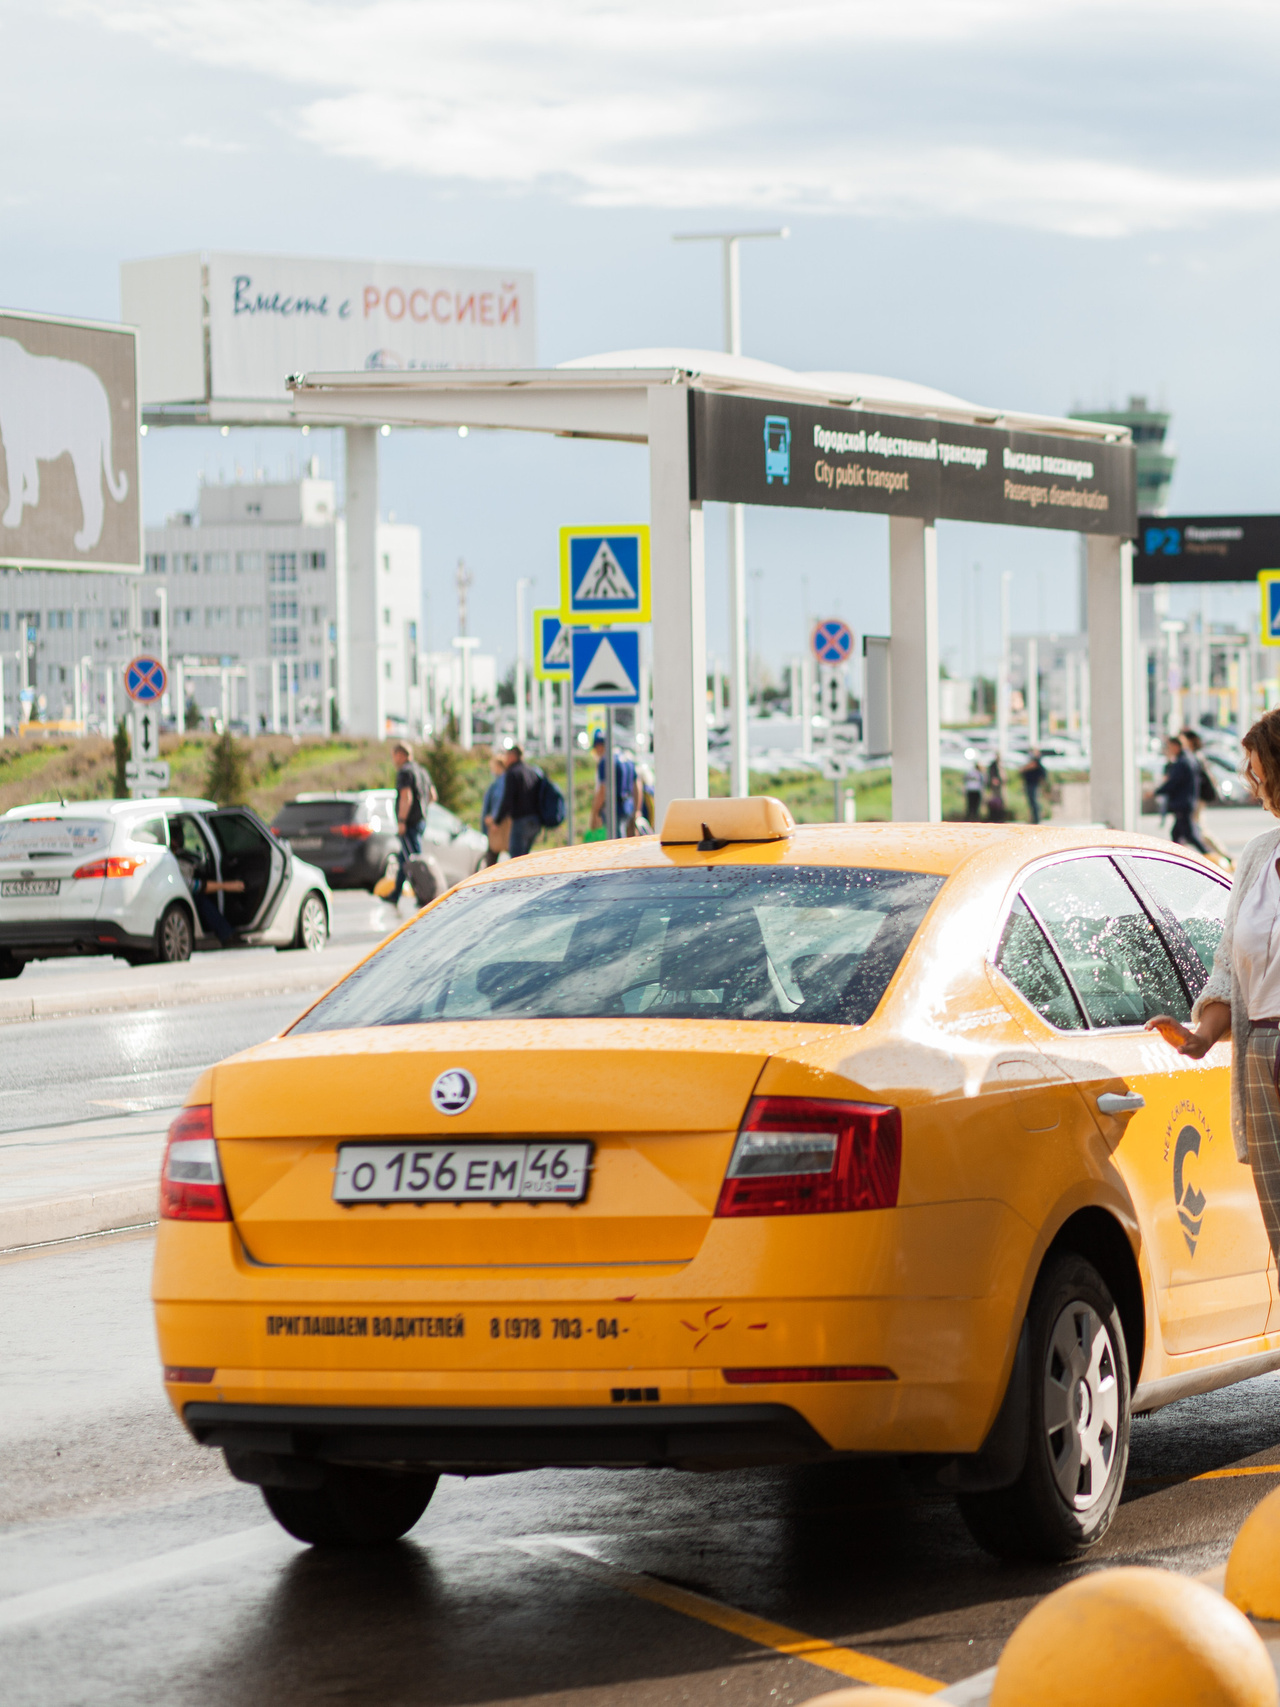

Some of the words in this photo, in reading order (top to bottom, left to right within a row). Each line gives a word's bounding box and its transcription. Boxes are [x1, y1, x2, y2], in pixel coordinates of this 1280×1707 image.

[232, 275, 330, 317] Вместе
[363, 282, 521, 327] РОССИЕЙ
[814, 424, 866, 454] Городской
[867, 430, 938, 460] общественный
[939, 443, 988, 470] транспорт
[814, 459, 834, 489] City
[836, 464, 865, 490] public
[866, 466, 909, 494] transport
[1004, 479, 1048, 508] Passengers
[1144, 527, 1181, 556] P2
[1171, 1099, 1196, 1122] CRIMEA
[1198, 1107, 1214, 1143] TAXI
[529, 1148, 570, 1180] 46
[267, 1316, 368, 1337] ПРИГЛАШАЕМ
[372, 1313, 466, 1341] ВОДИТЕЛЕЙ
